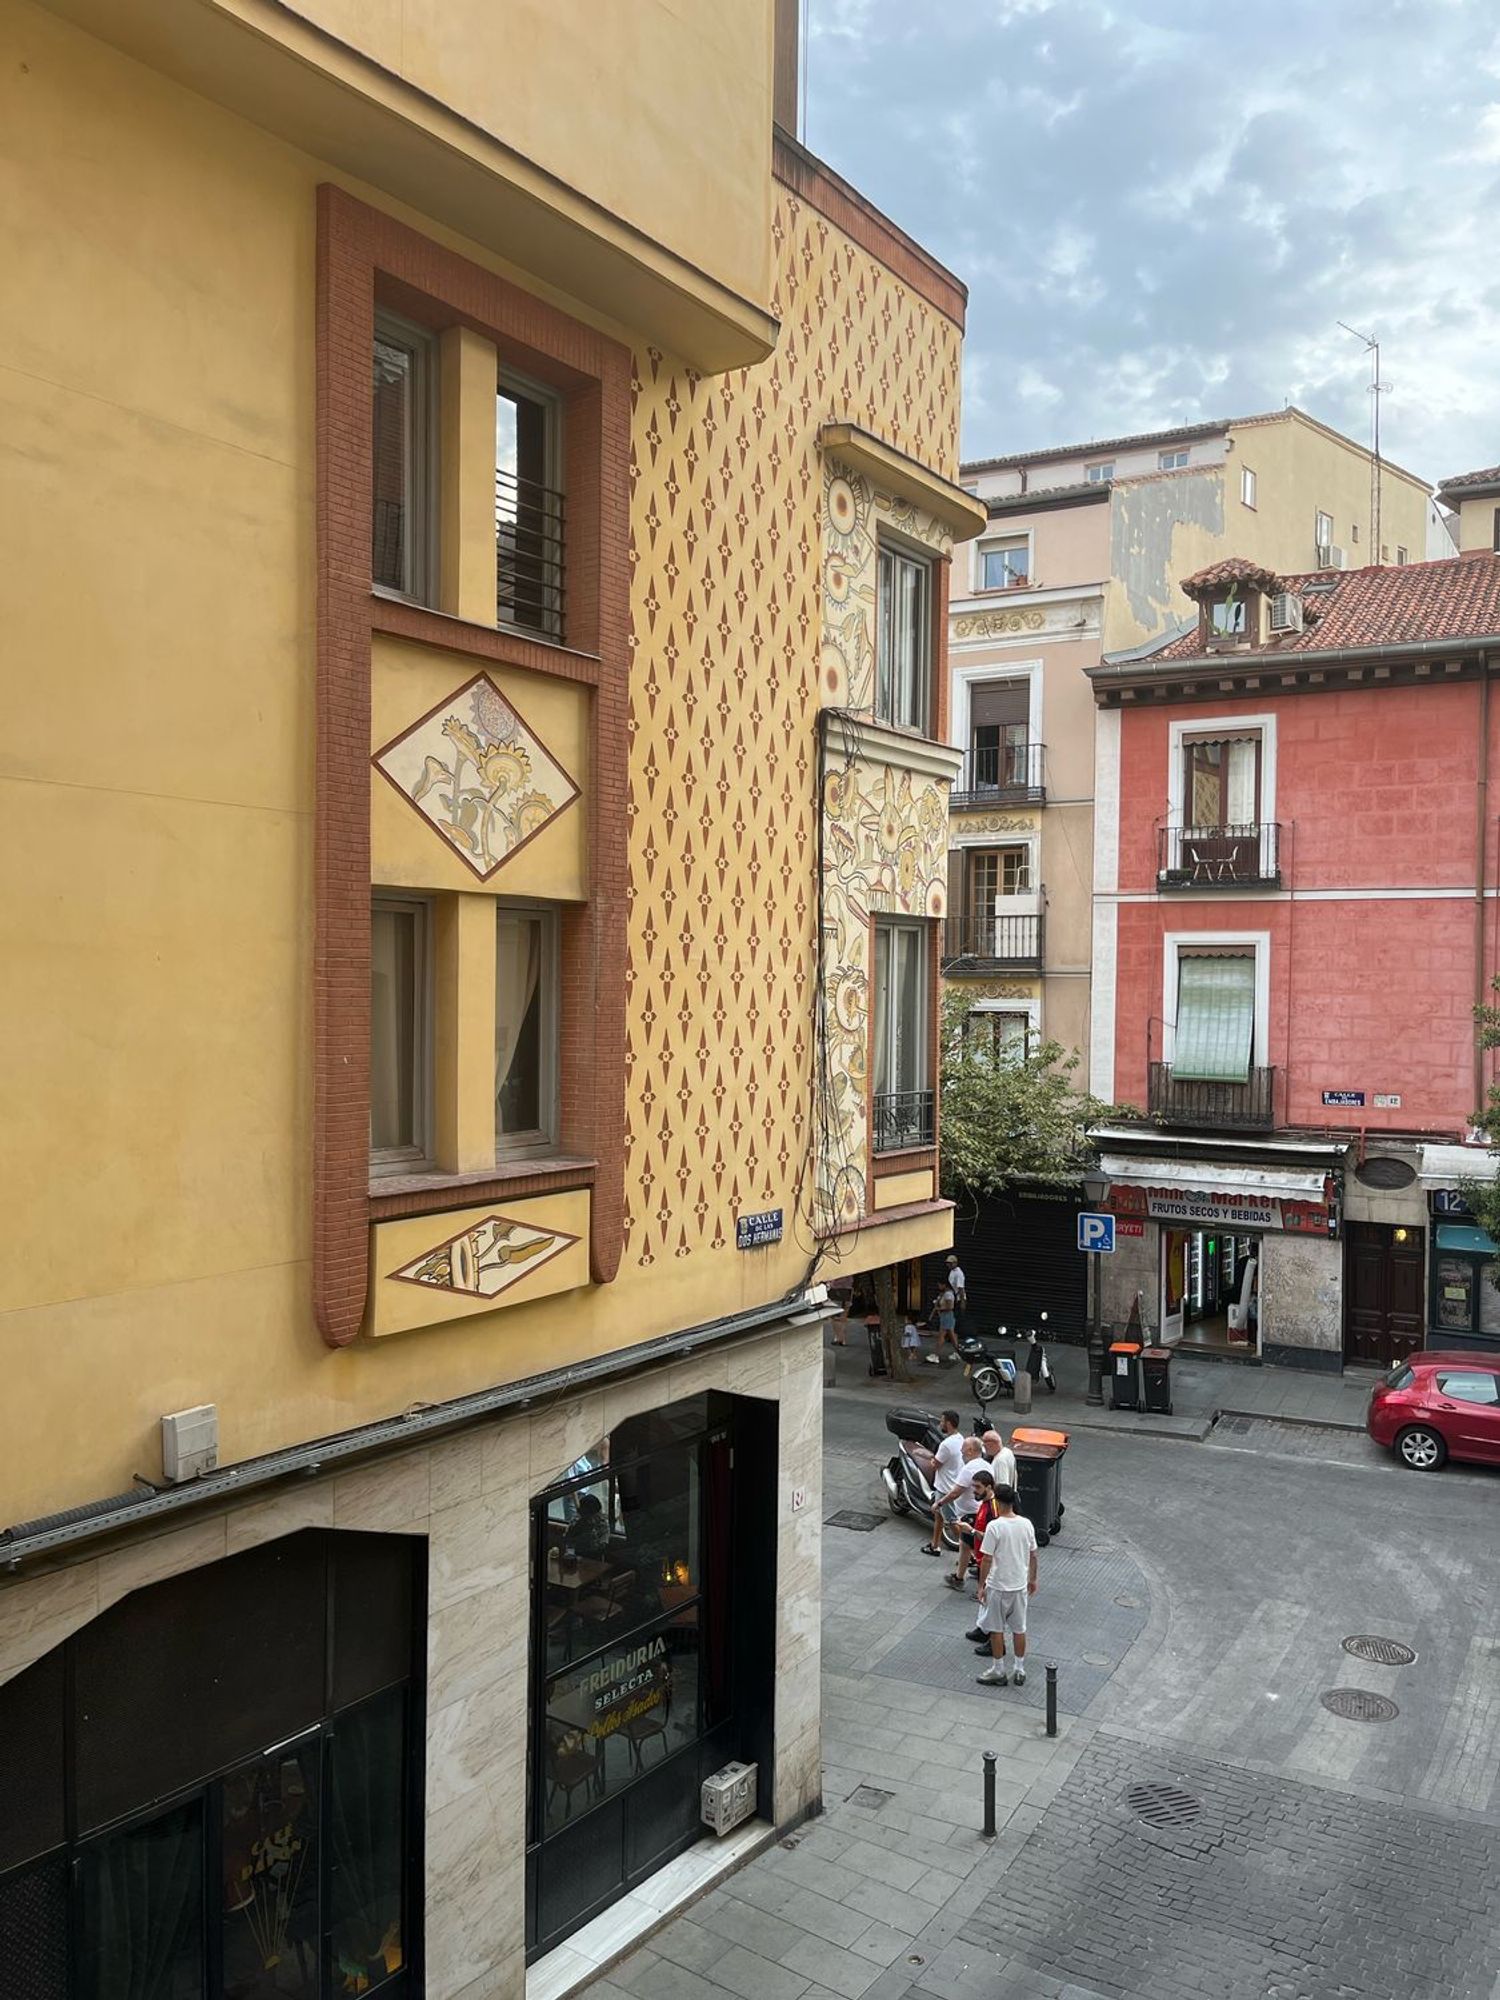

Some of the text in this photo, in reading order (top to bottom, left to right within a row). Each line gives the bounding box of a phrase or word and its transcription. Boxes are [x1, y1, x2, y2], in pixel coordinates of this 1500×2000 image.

[1152, 1202, 1272, 1223] FRUTOS SECOS Y BEBIDAS
[1440, 1191, 1461, 1211] 12
[749, 1212, 779, 1226] CALLE
[1083, 1218, 1105, 1247] P
[580, 1637, 667, 1697] FREIDURIA
[594, 1669, 654, 1710] SELECTA
